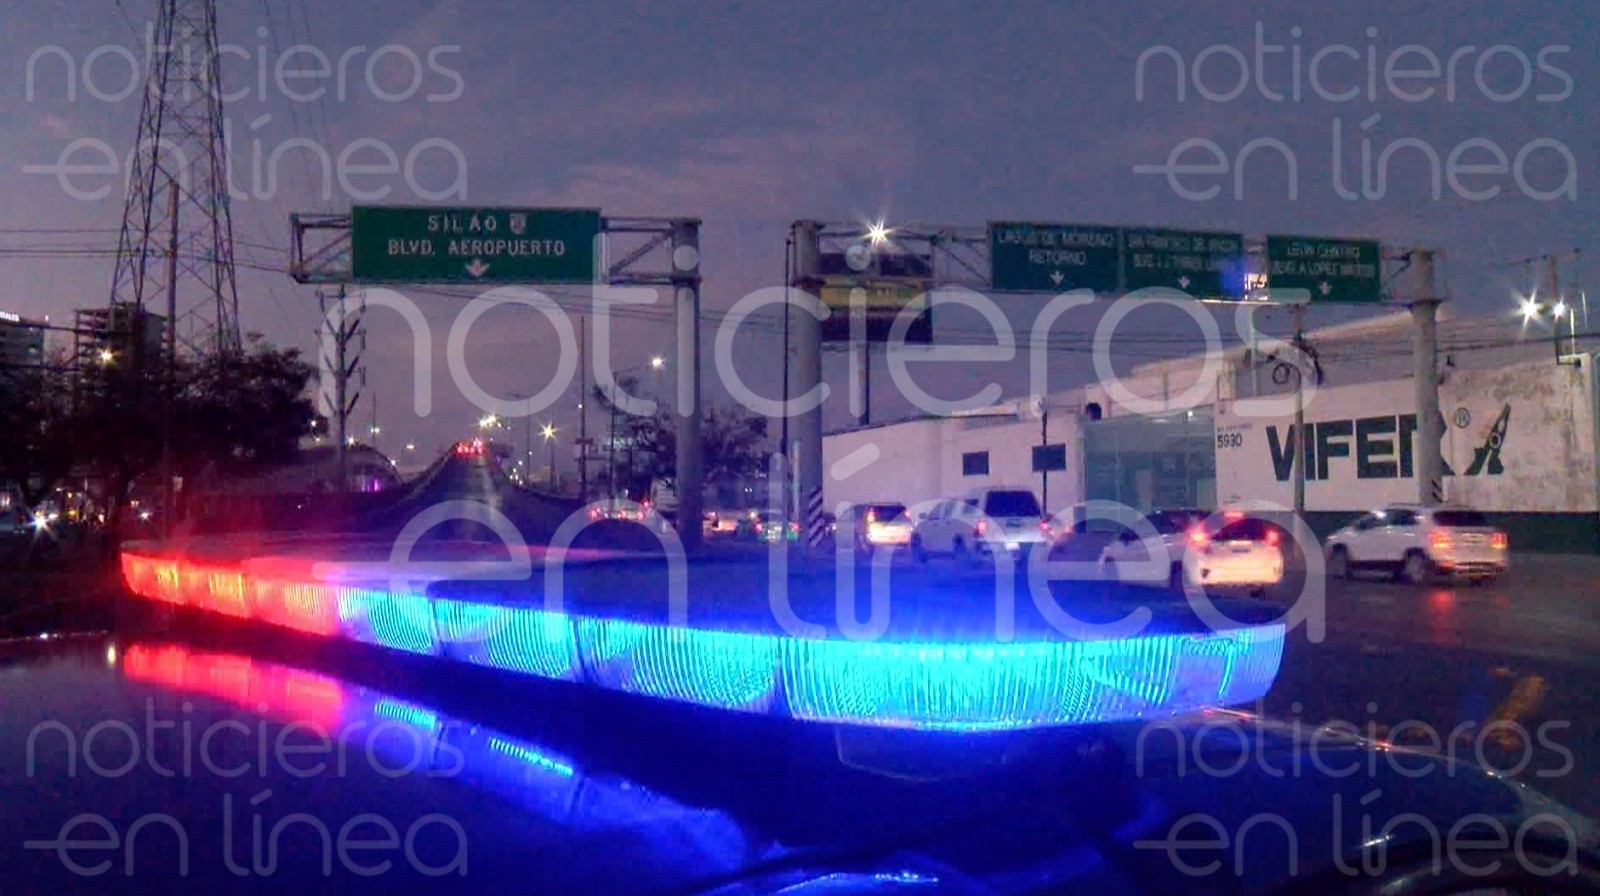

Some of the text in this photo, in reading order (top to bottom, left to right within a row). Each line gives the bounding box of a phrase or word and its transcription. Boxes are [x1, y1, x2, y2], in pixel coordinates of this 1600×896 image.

[428, 213, 497, 232] SILAO
[388, 239, 566, 256] BLVD. AEROPUERTO
[1029, 249, 1087, 266] RETORNO
[1217, 433, 1243, 449] 5930
